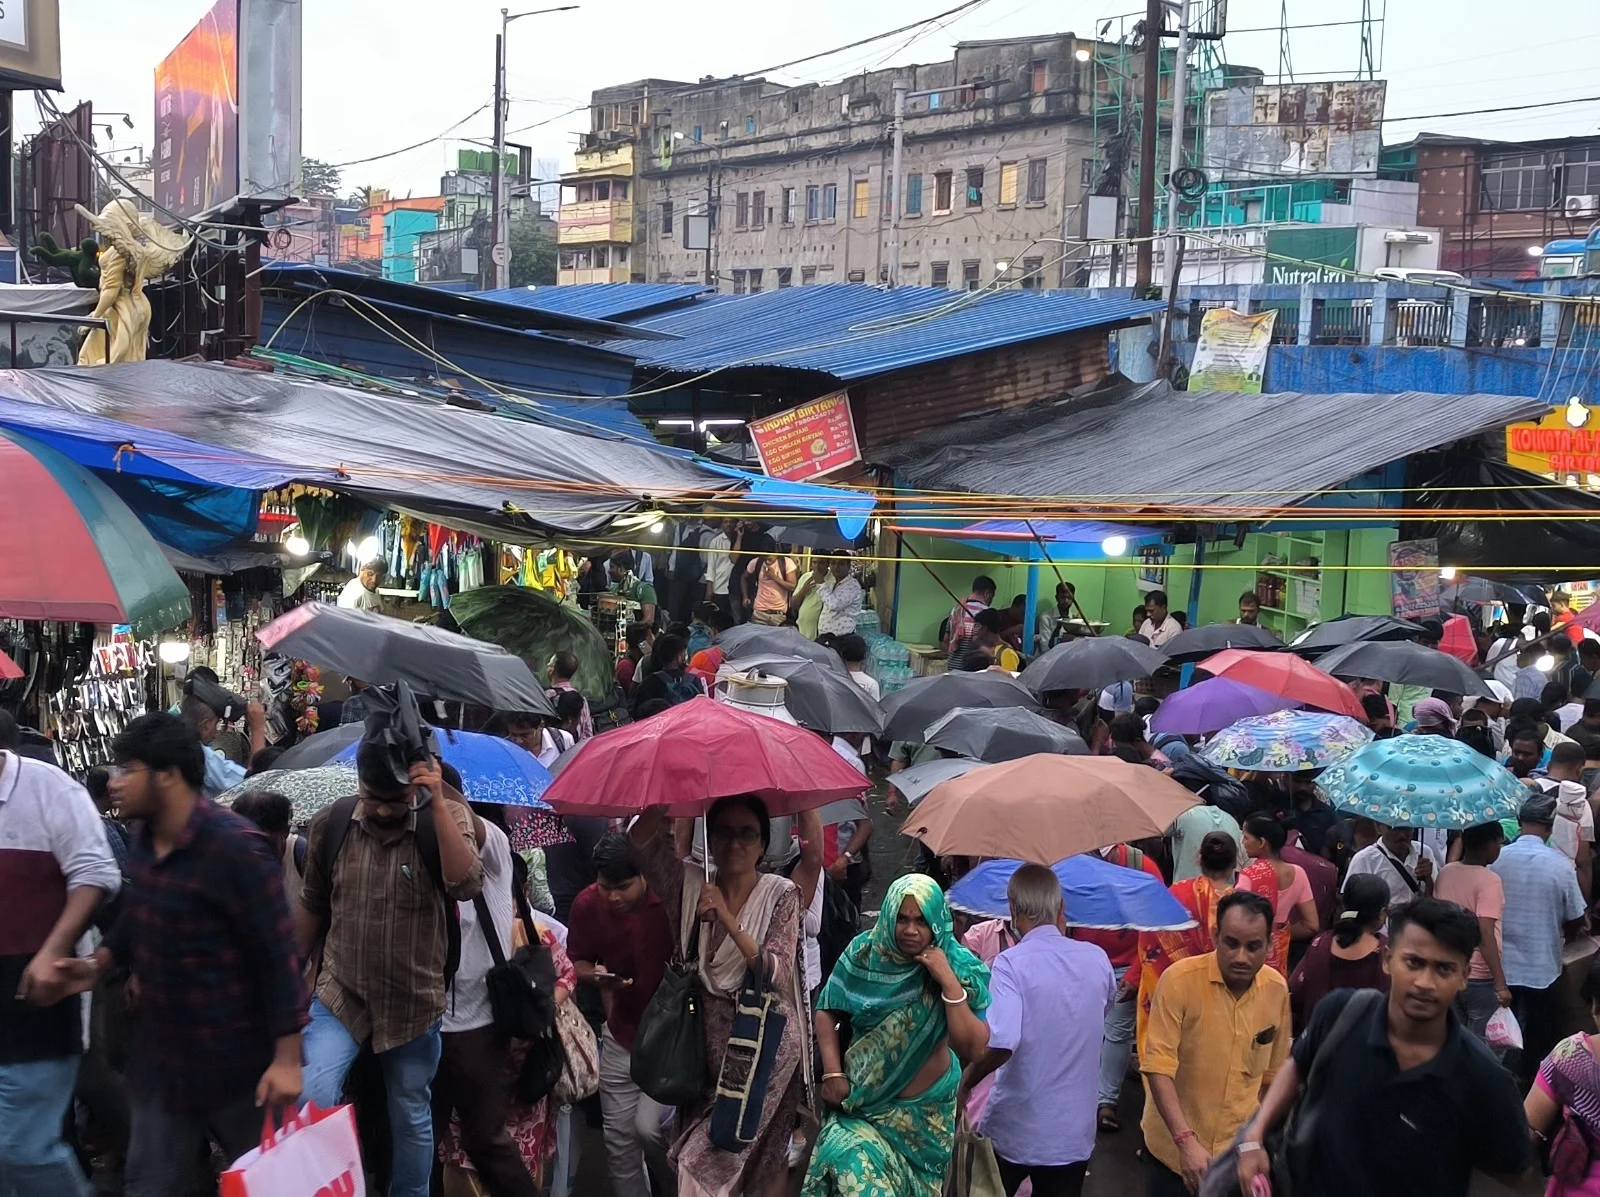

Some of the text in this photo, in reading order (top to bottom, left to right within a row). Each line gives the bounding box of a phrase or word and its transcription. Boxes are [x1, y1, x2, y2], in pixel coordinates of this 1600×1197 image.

[763, 398, 837, 433] INDIAN BIRYANI
[787, 426, 809, 439] BIRYANI
